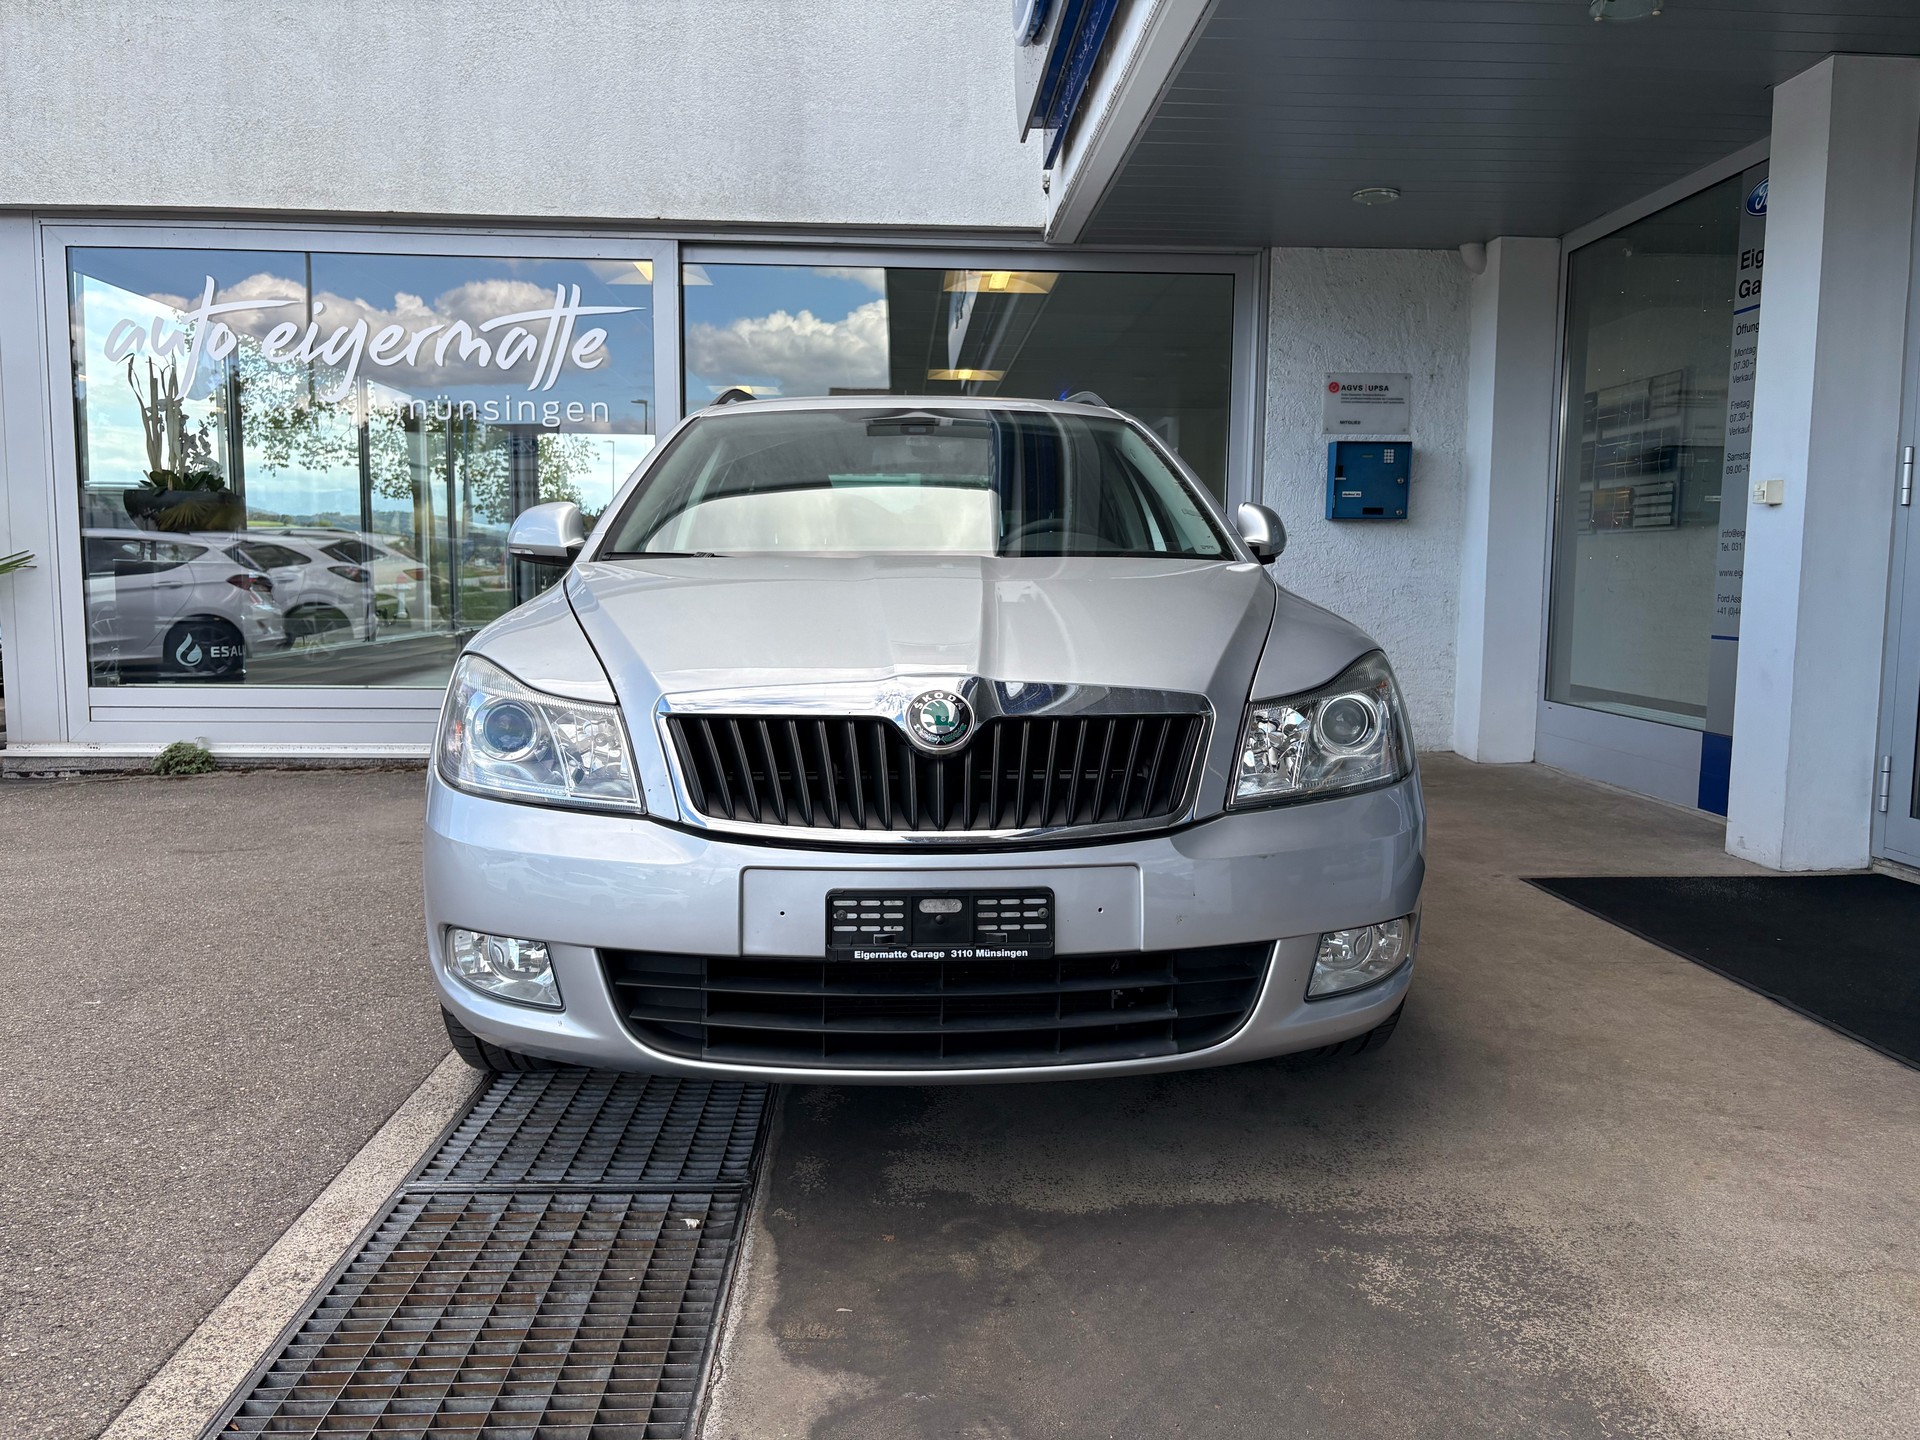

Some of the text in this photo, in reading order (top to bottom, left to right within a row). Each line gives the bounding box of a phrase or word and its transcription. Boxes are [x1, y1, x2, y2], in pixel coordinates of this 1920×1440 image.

[1738, 279, 1761, 299] Ga
[104, 275, 646, 404] auto eigermatte
[393, 394, 610, 427] münsingen
[854, 948, 1029, 960] Eigermatte Garage 3110 Münsingen
